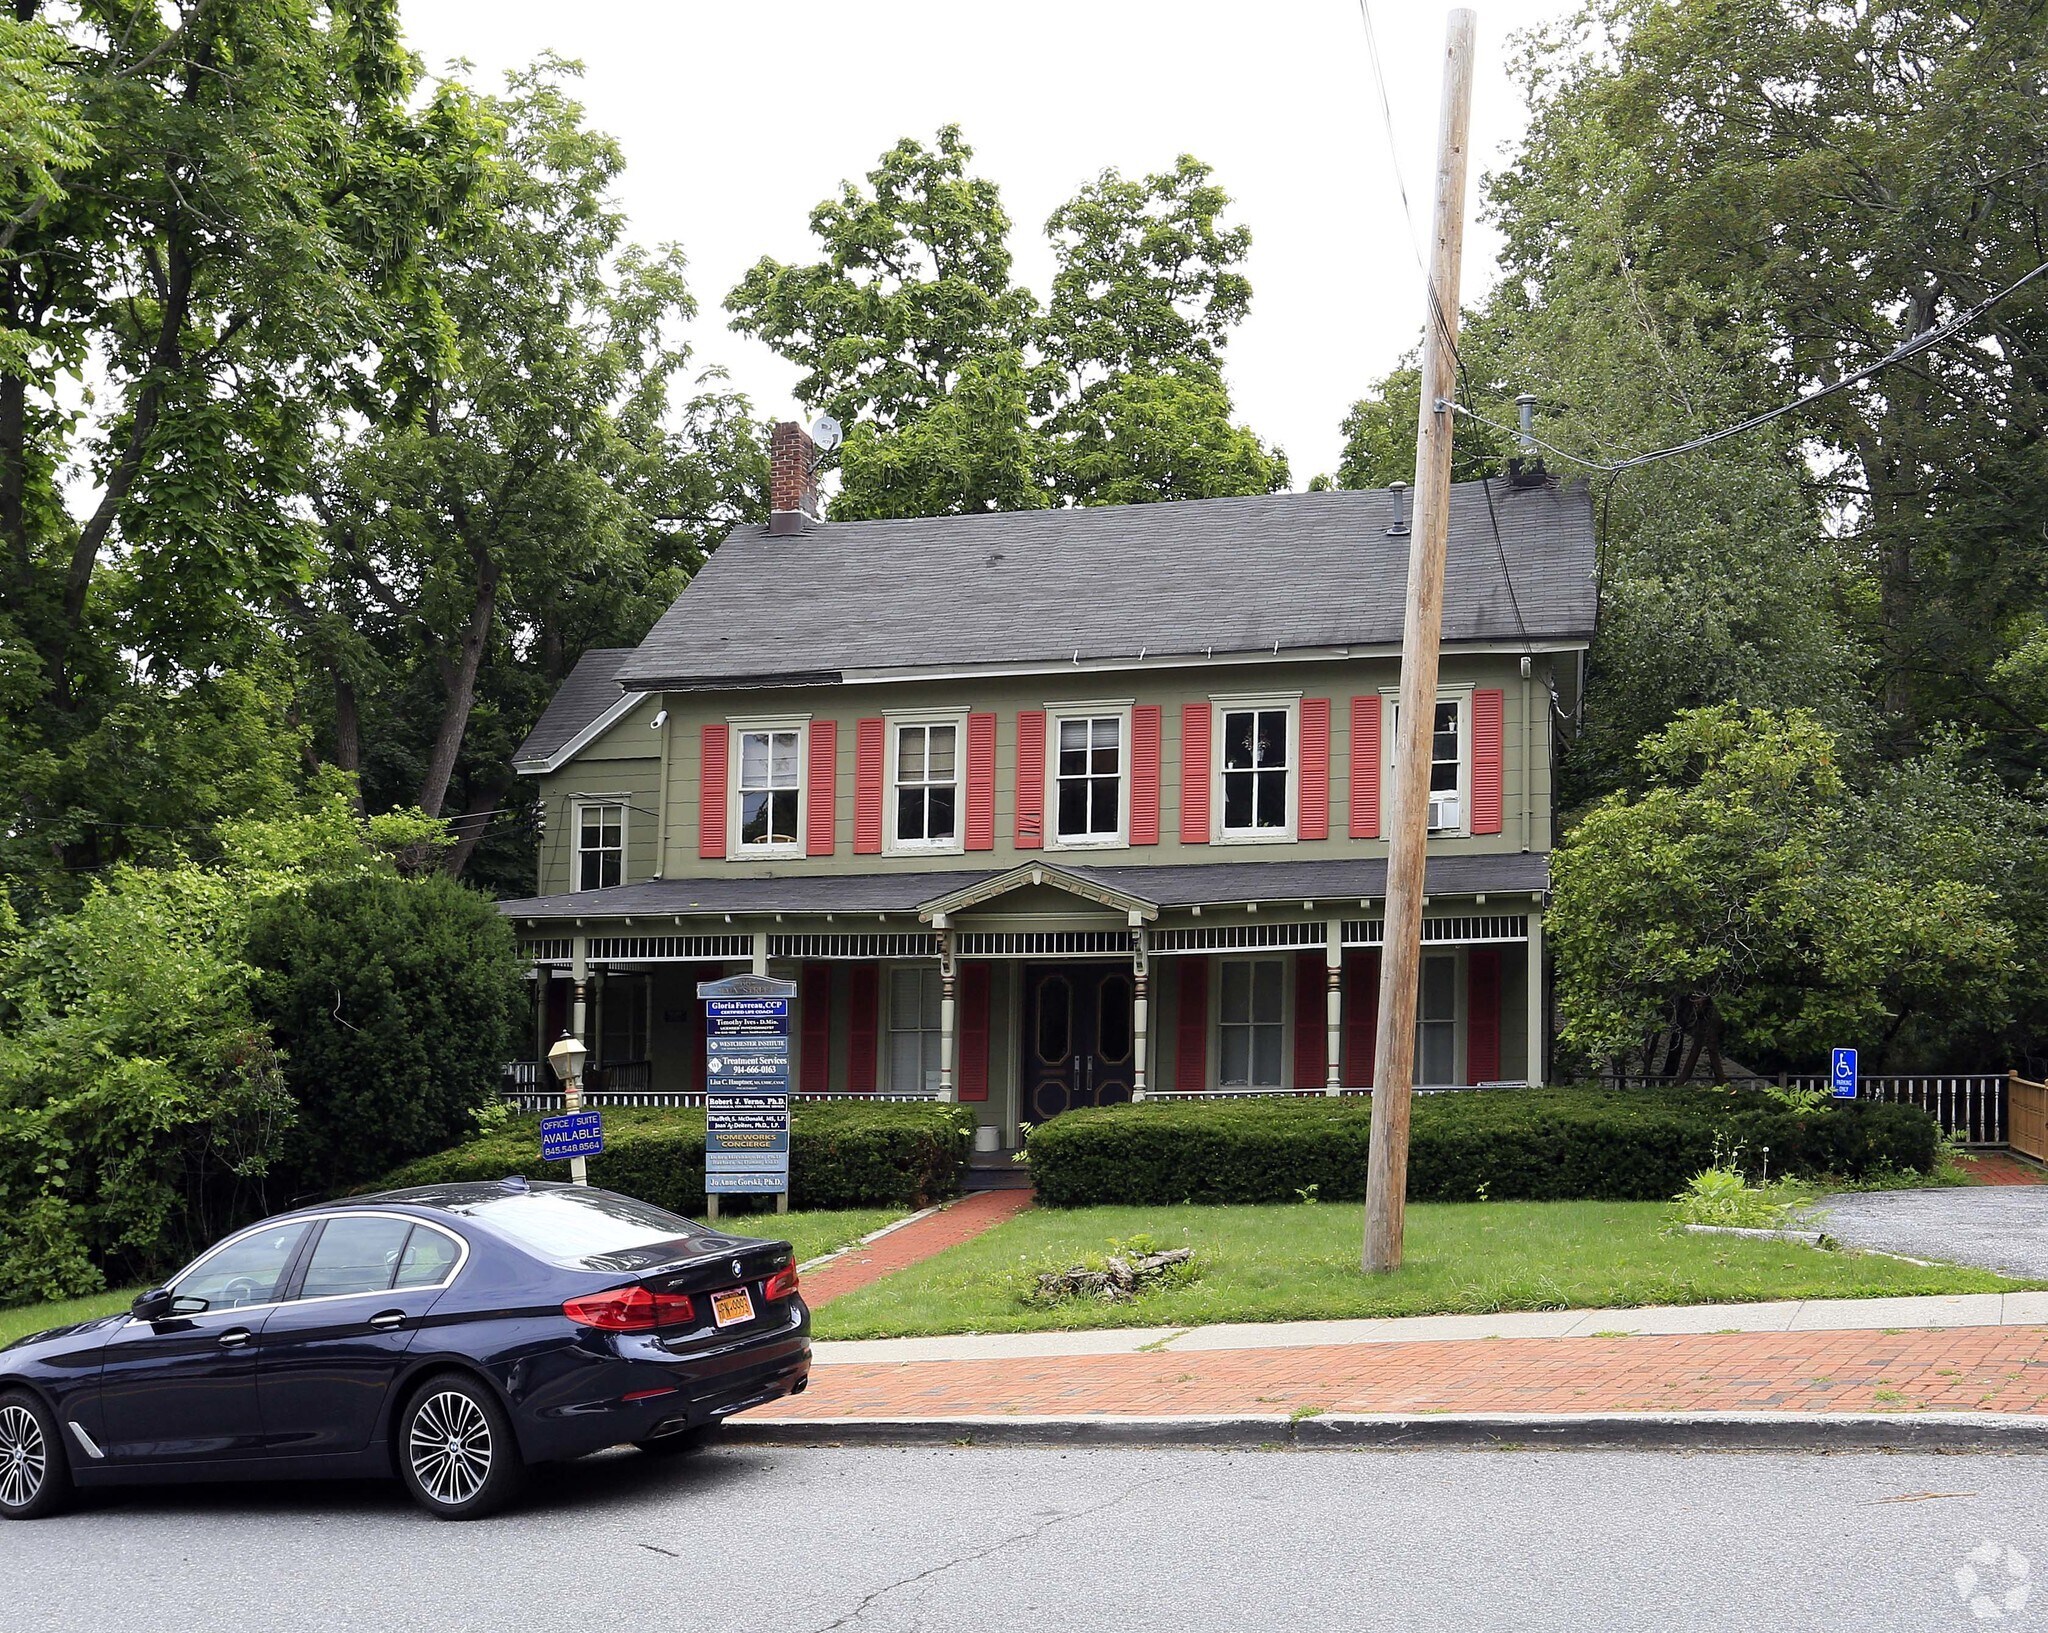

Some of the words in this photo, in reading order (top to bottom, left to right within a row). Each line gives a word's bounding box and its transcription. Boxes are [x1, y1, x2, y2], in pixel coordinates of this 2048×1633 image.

[711, 1002, 735, 1010] Gloria
[716, 1019, 743, 1027] Timothy
[722, 1057, 758, 1065] Treatment
[759, 1056, 787, 1065] Services
[733, 1065, 776, 1074] 914-666-0163
[543, 1119, 569, 1130] OFFICE
[571, 1118, 575, 1127] /
[577, 1115, 597, 1126] SUITE
[543, 1127, 601, 1144] AVAILABLE
[545, 1141, 600, 1156] 845.548.8564
[737, 1178, 763, 1186] Gorski,
[763, 1178, 783, 1186] Ph.D.
